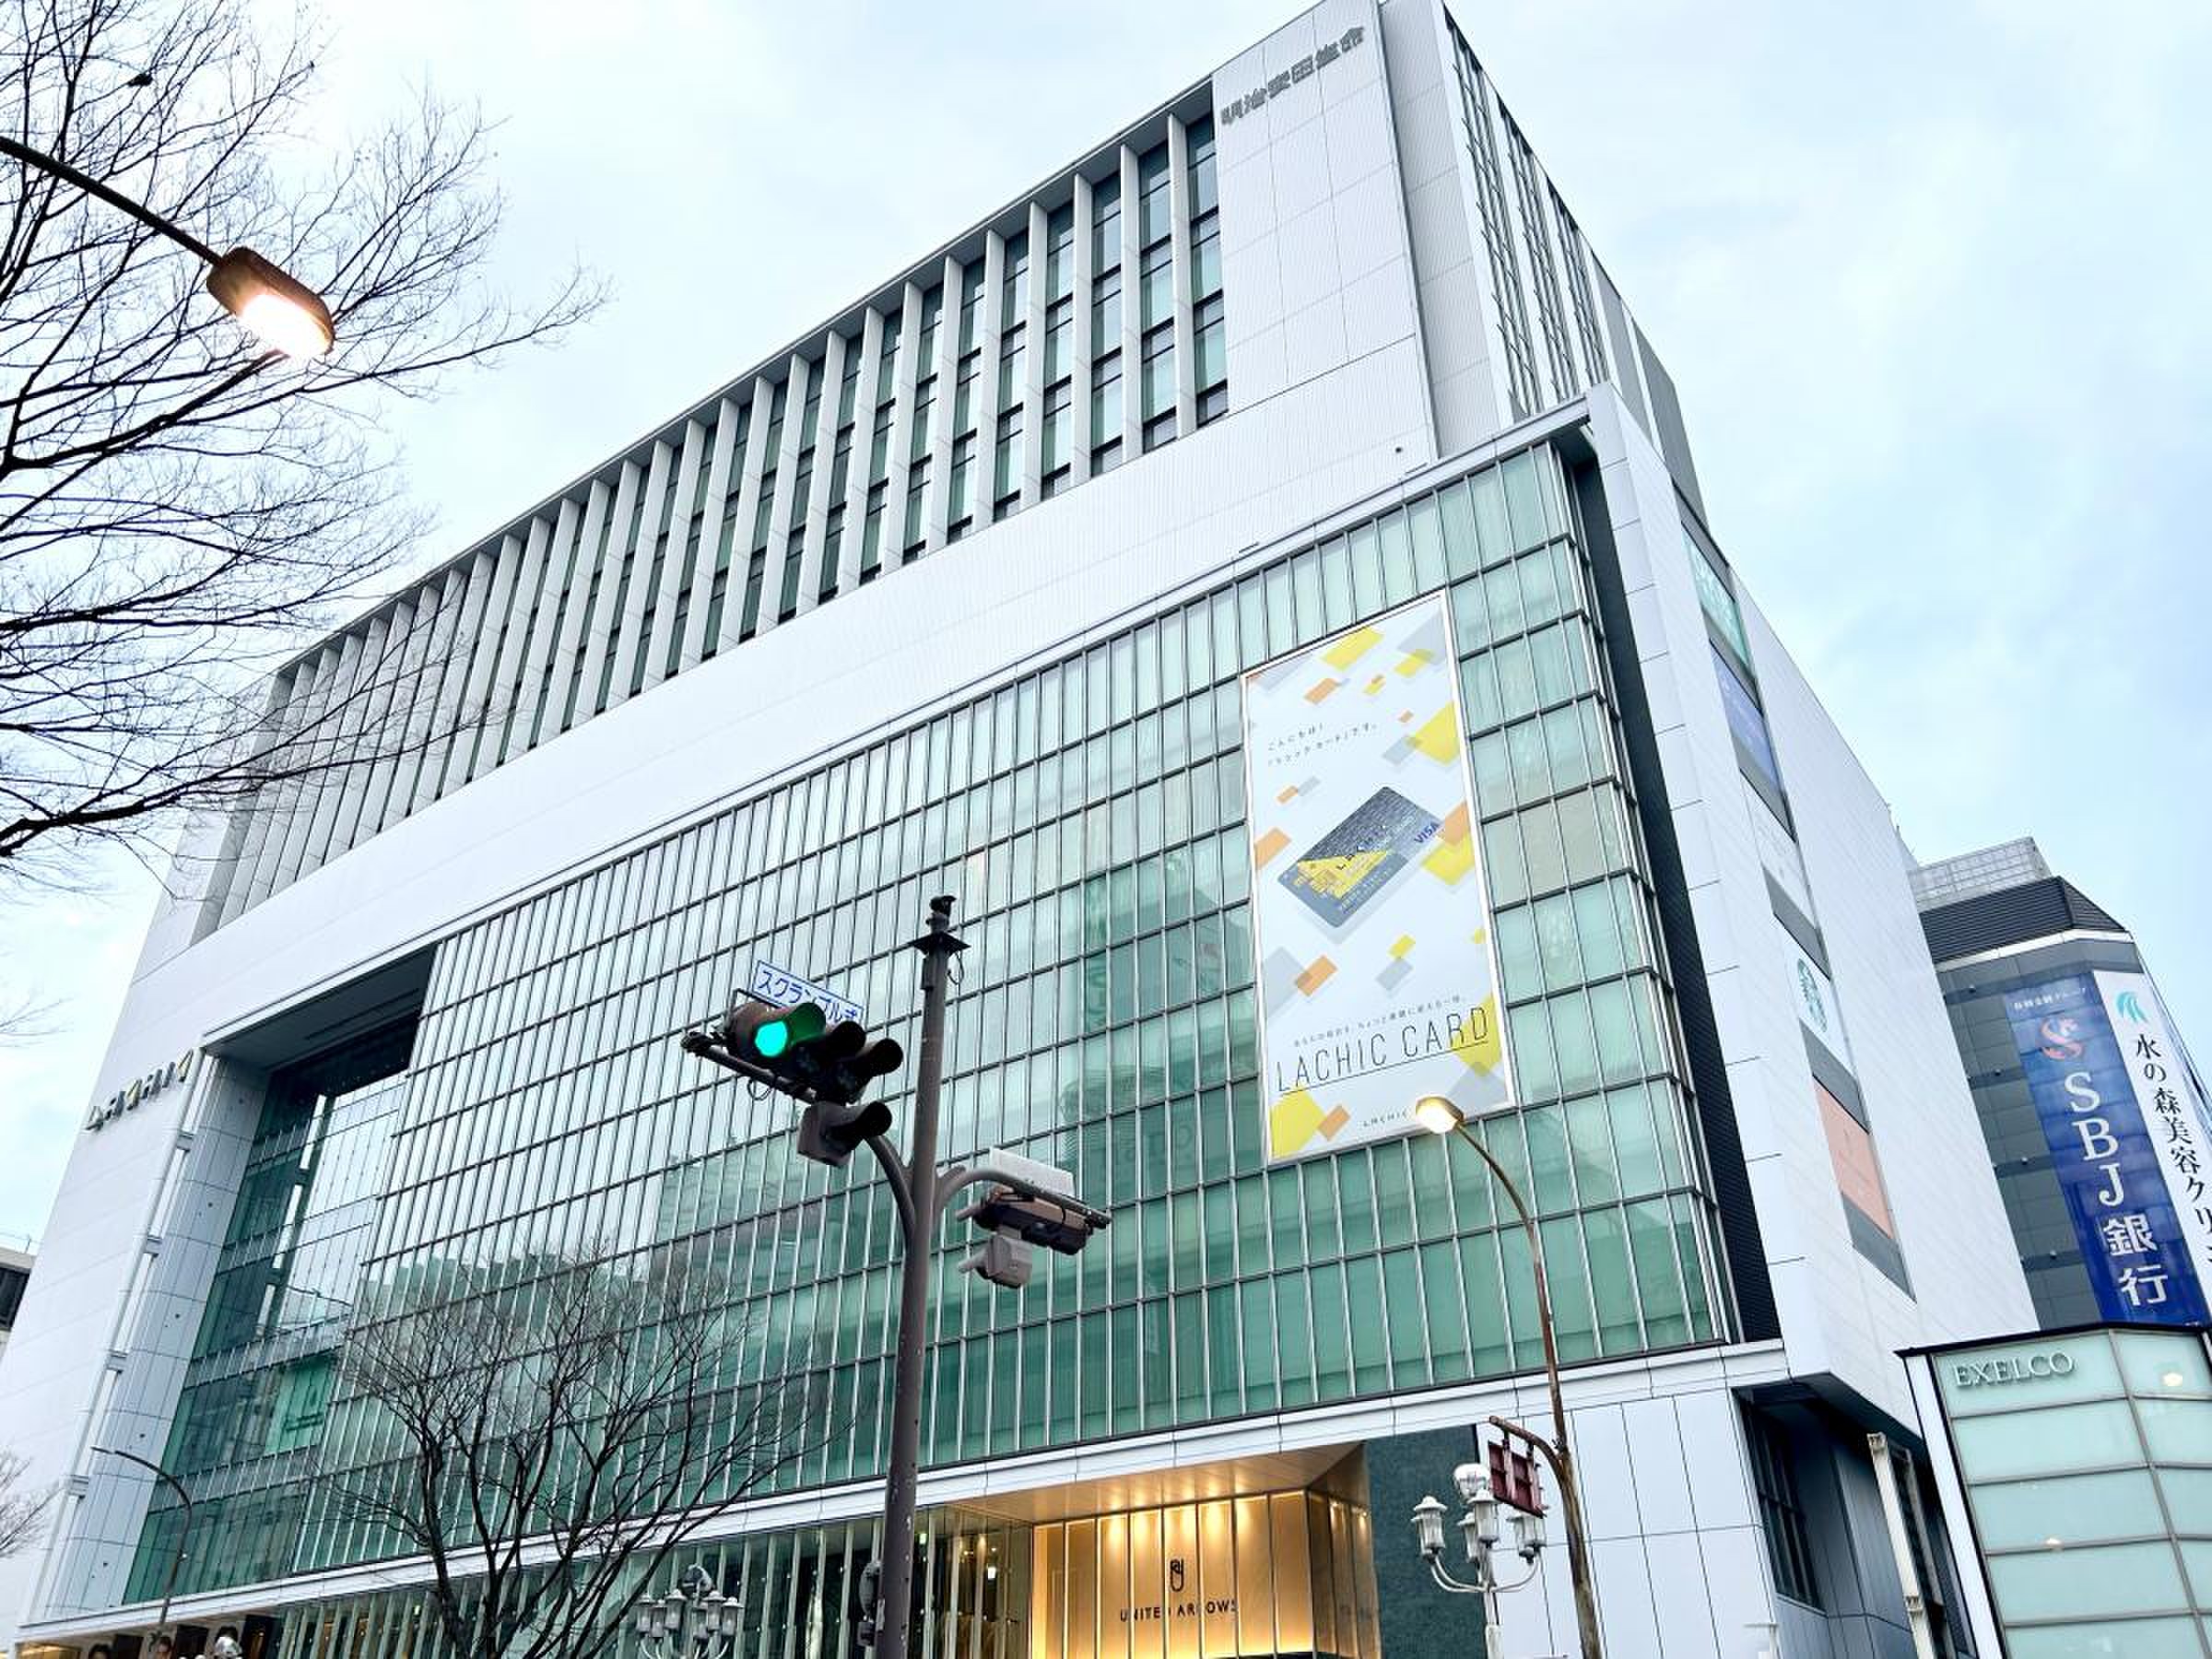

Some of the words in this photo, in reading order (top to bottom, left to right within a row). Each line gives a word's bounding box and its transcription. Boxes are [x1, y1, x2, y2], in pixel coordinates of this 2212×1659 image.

[1414, 821, 1441, 845] VISA
[1277, 1032, 1387, 1092] LACHIC
[1402, 1006, 1488, 1059] CARD
[2136, 1033, 2212, 1264] 水の森美容クリ
[2064, 1071, 2169, 1307] SBJ銀行
[1953, 1351, 2075, 1388] EXELCO
[1120, 1606, 1171, 1622] UNITE
[1176, 1599, 1237, 1617] AROWS
